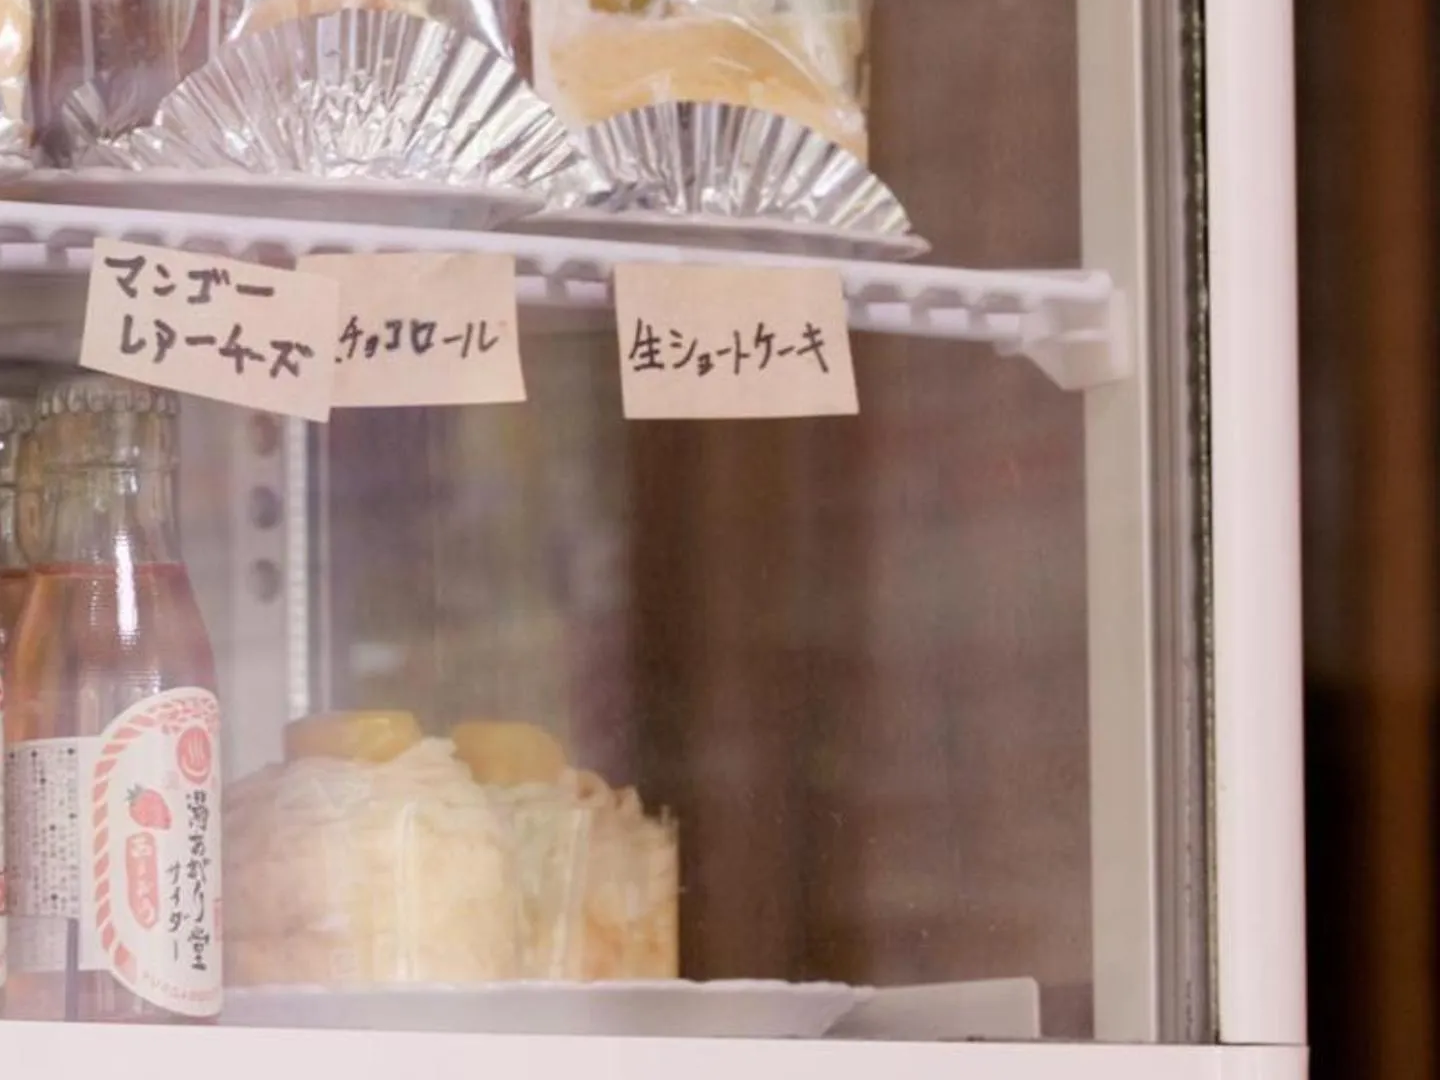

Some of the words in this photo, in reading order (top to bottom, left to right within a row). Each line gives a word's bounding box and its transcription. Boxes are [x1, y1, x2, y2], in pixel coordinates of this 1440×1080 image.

[104, 255, 276, 304] マンゴー
[338, 315, 500, 360] チョコロール
[628, 316, 830, 378] 生ショートケーキ
